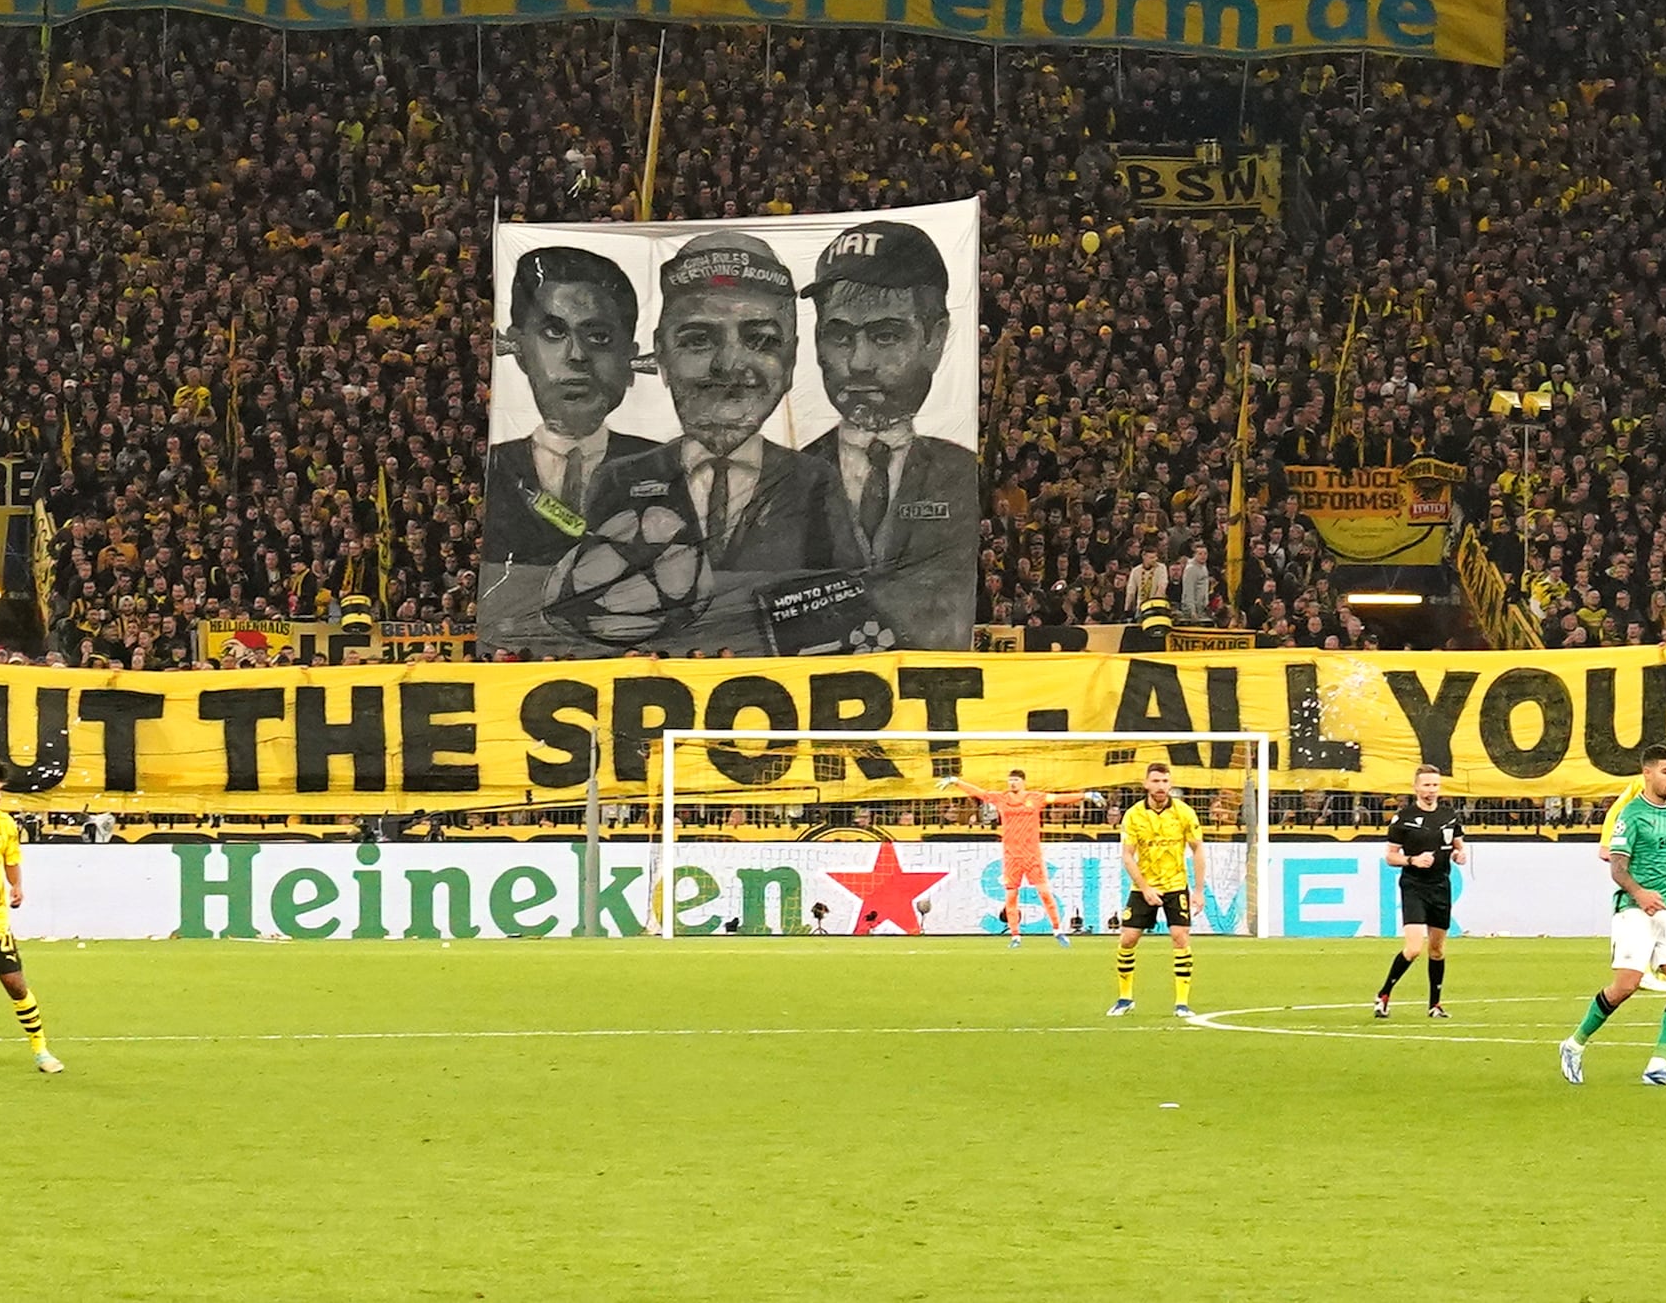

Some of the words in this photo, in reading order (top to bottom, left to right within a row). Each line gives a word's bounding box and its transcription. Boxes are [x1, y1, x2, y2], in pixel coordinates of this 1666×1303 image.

[742, 267, 789, 286] AROUND
[773, 591, 803, 609] HOW
[803, 587, 822, 601] TO
[772, 605, 799, 622] THE
[209, 619, 290, 635] HEILIGENHAUS
[199, 682, 480, 794] THE
[520, 667, 984, 790] SPORT
[1027, 708, 1071, 734] -
[1106, 658, 1361, 772] ALL
[171, 844, 802, 940] Heineken
[980, 857, 1464, 938] SIVE
